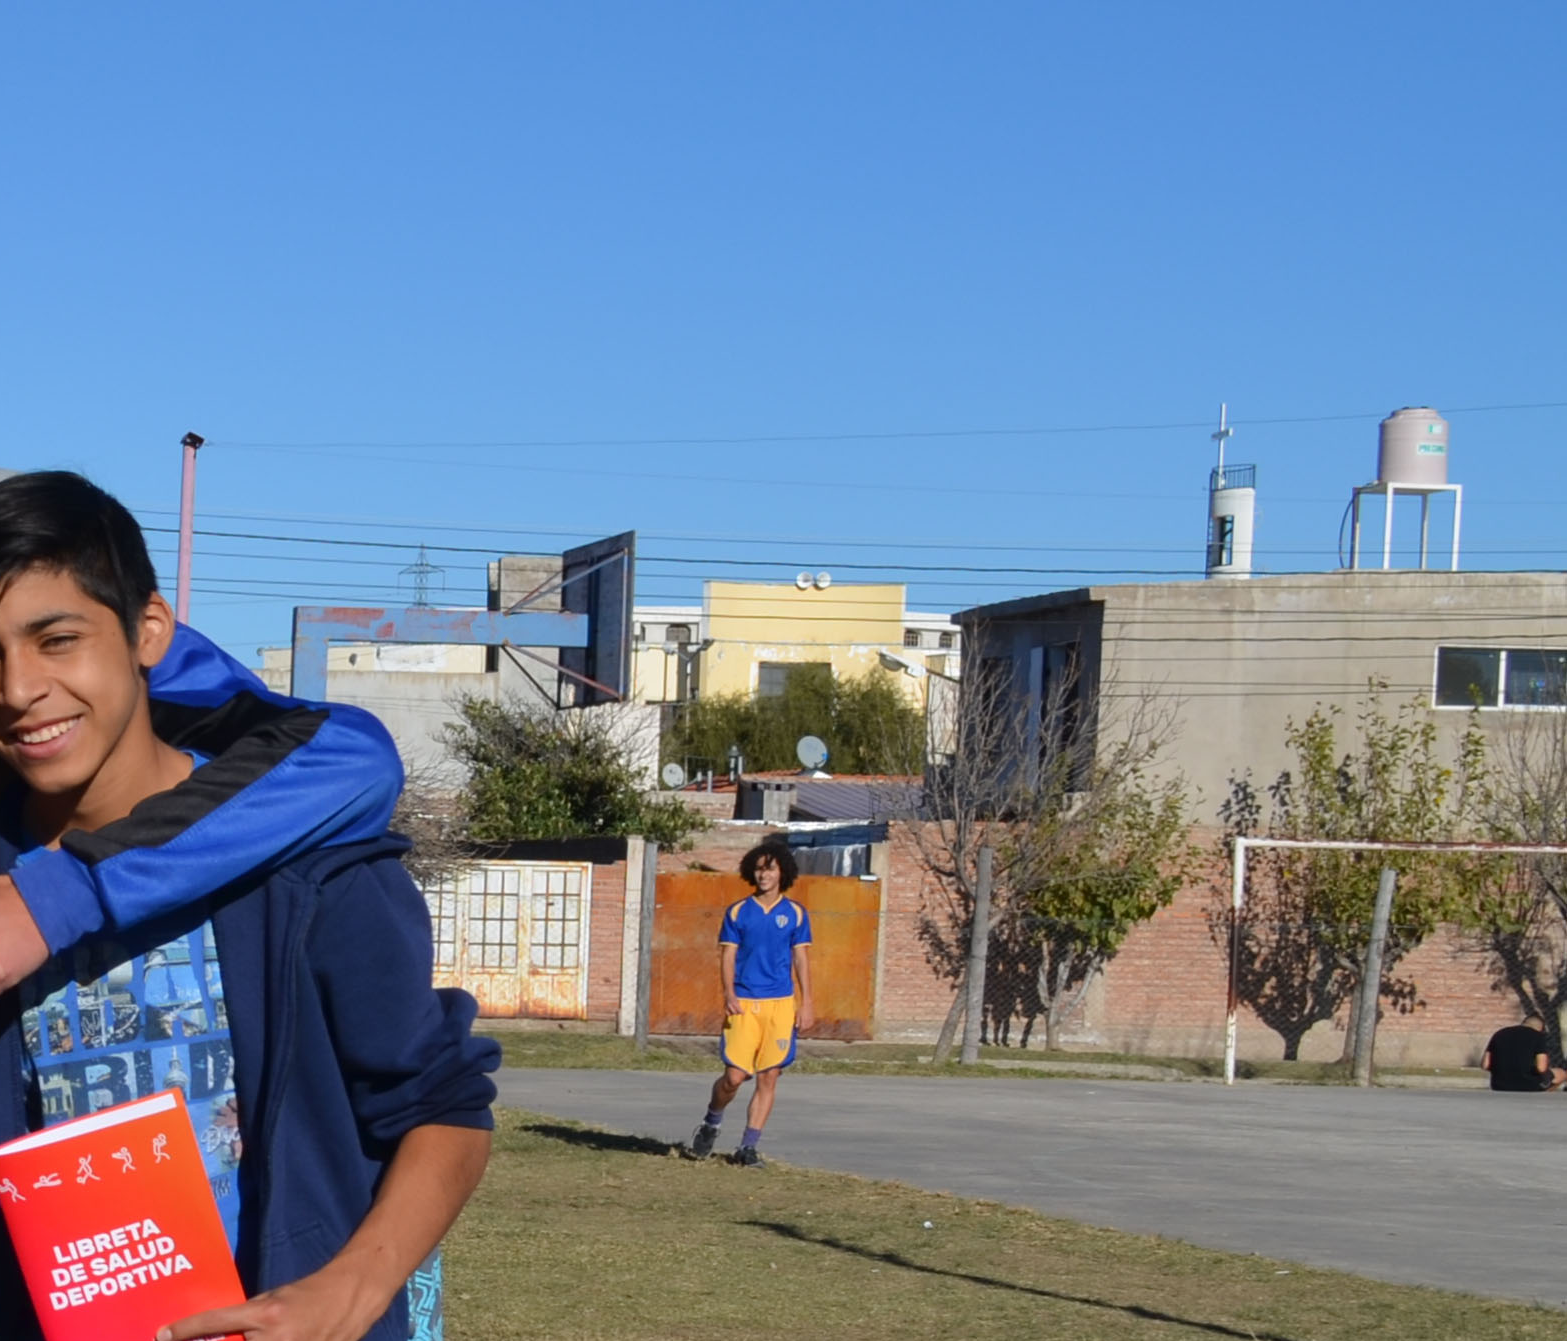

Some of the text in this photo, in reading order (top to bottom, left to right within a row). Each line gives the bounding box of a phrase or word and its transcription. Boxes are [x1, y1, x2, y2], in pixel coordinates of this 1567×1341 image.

[51, 1236, 175, 1287] DE SALUD
[53, 1218, 162, 1264] LIBRETA
[49, 1254, 193, 1311] DEPORTIVA
